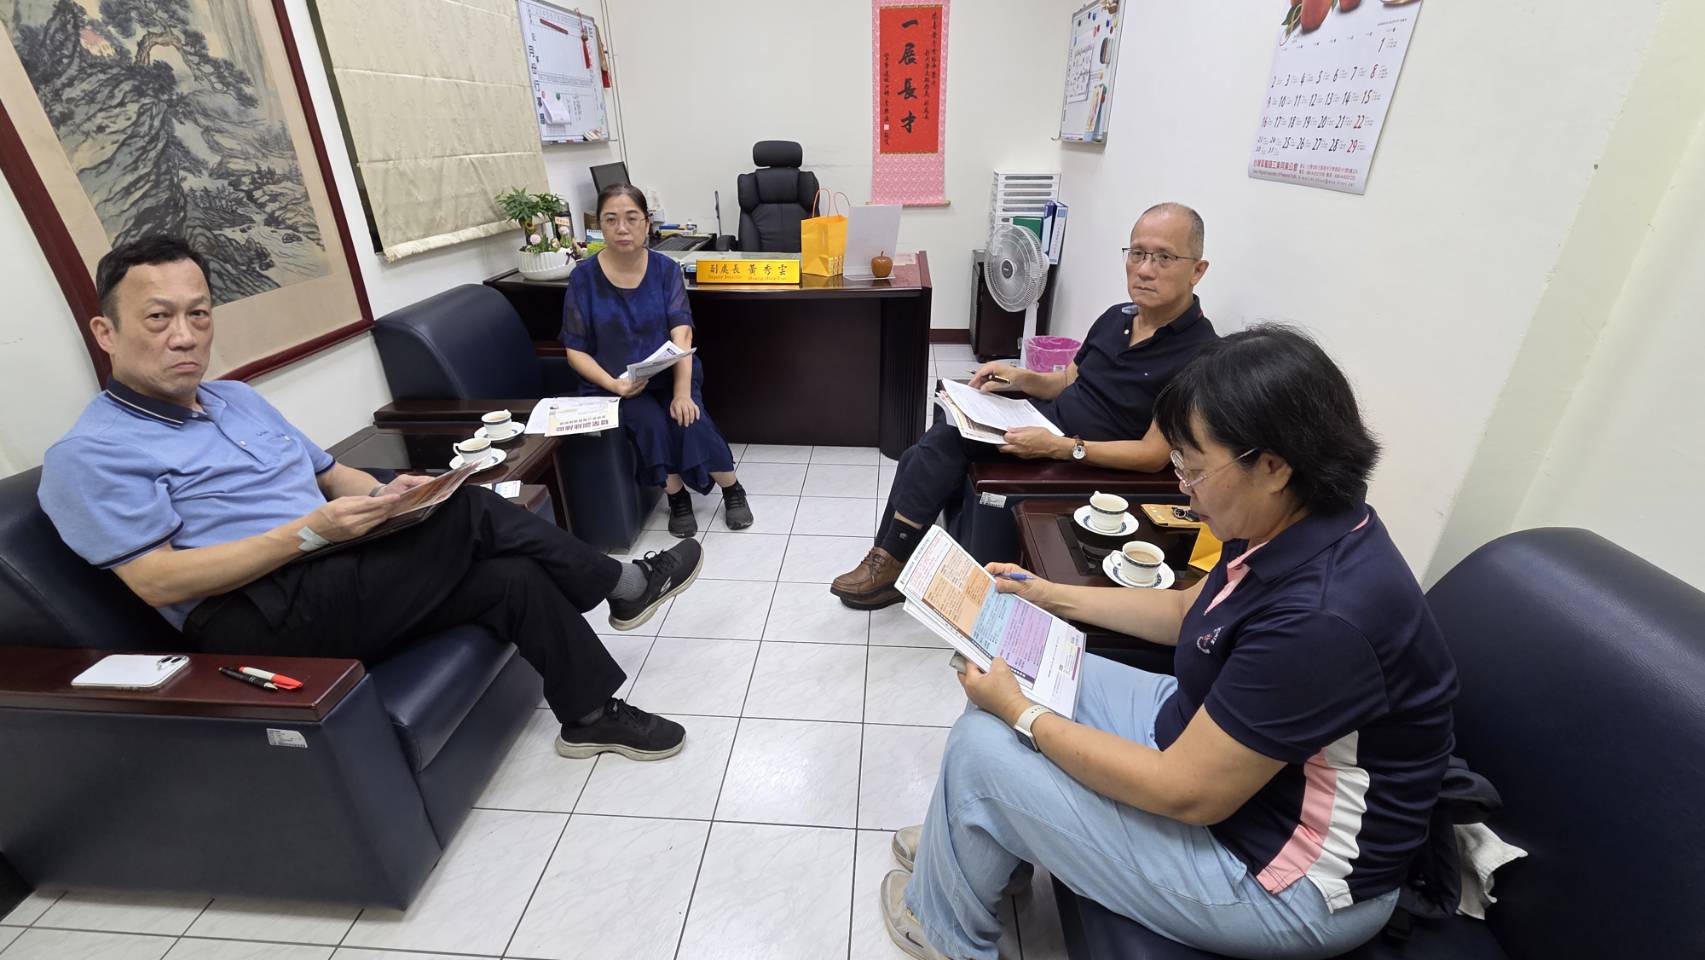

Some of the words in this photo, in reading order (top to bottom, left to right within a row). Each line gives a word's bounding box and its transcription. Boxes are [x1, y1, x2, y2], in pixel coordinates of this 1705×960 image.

[1378, 37, 1386, 53] 1
[897, 18, 919, 134] 一展長才
[1271, 76, 1276, 88] 2
[1285, 74, 1290, 86] 3
[1300, 73, 1305, 86] 4
[1316, 70, 1323, 83] 5
[1333, 68, 1339, 82] 6
[1350, 66, 1357, 80] 7
[1370, 64, 1378, 79] 8
[1279, 96, 1286, 107] 10
[1294, 95, 1301, 107] 11
[1309, 94, 1317, 106] 12
[1325, 92, 1334, 105] 13
[1342, 91, 1351, 106] 14
[1361, 90, 1372, 104] 15
[1274, 116, 1282, 127] 17
[1288, 116, 1296, 128] 18
[1303, 116, 1311, 128] 19
[1317, 116, 1327, 128] 20
[1335, 115, 1345, 128] 21
[1353, 115, 1365, 129] 22
[1282, 137, 1290, 149] 25
[1296, 137, 1305, 150] 26
[1312, 138, 1322, 151] 27
[1329, 139, 1339, 151] 28
[1347, 139, 1358, 153] 29
[710, 263, 741, 274] 副處長
